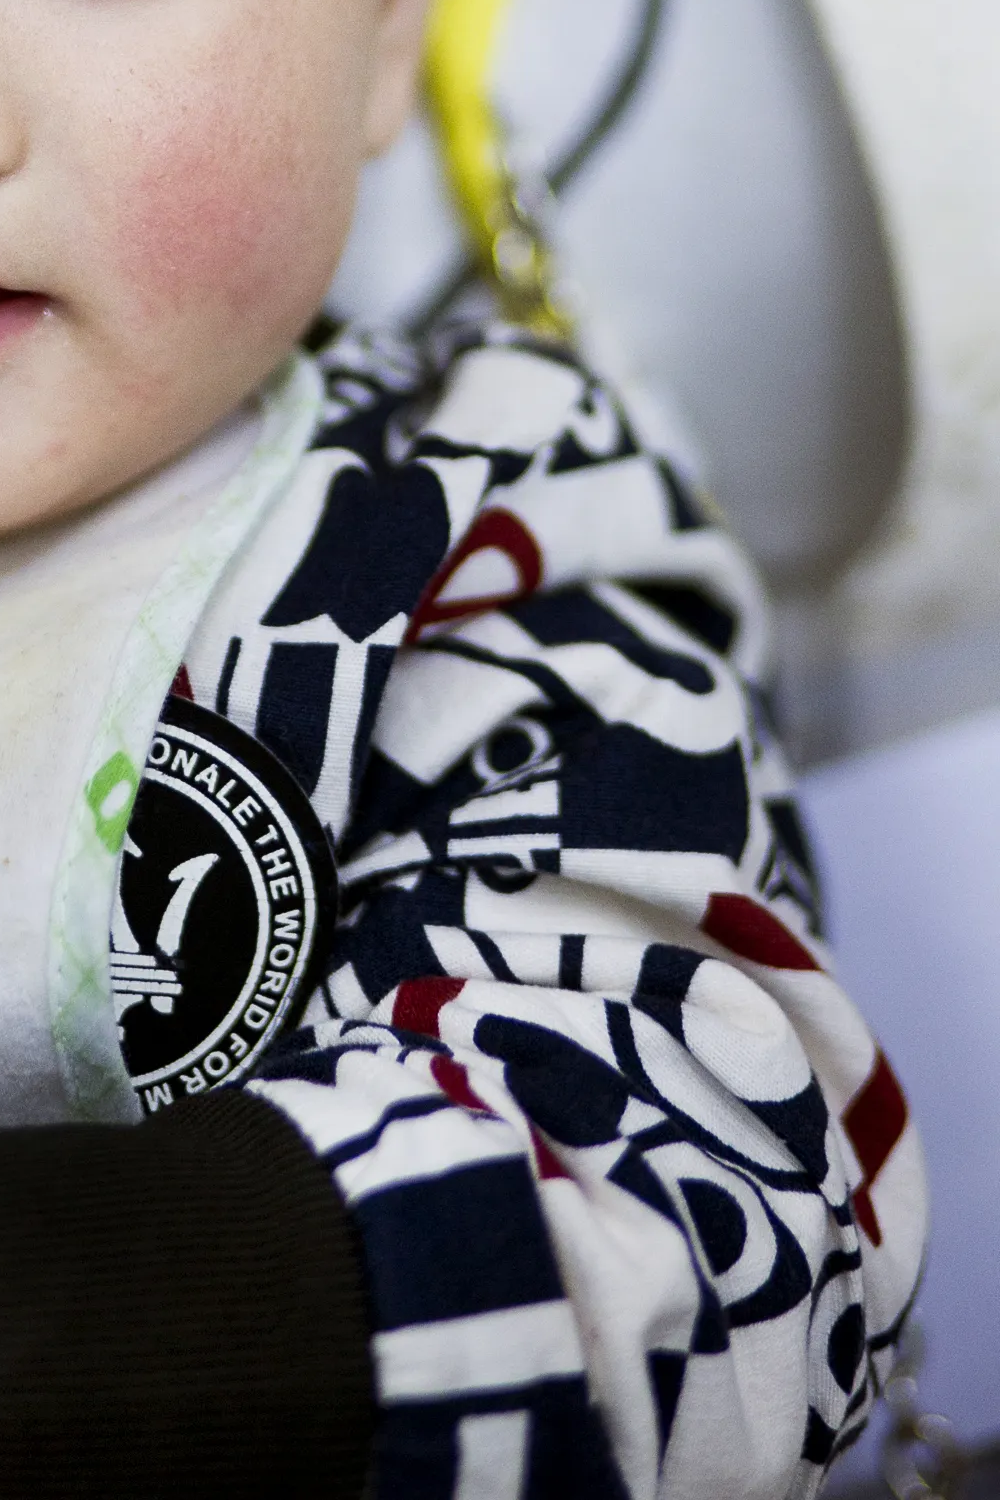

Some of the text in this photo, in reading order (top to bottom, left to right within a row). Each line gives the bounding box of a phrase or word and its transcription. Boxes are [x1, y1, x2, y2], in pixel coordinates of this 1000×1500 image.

[148, 736, 262, 827] ONALE
[256, 823, 300, 901] THE
[143, 1082, 175, 1113] M
[178, 1032, 249, 1095] FOR
